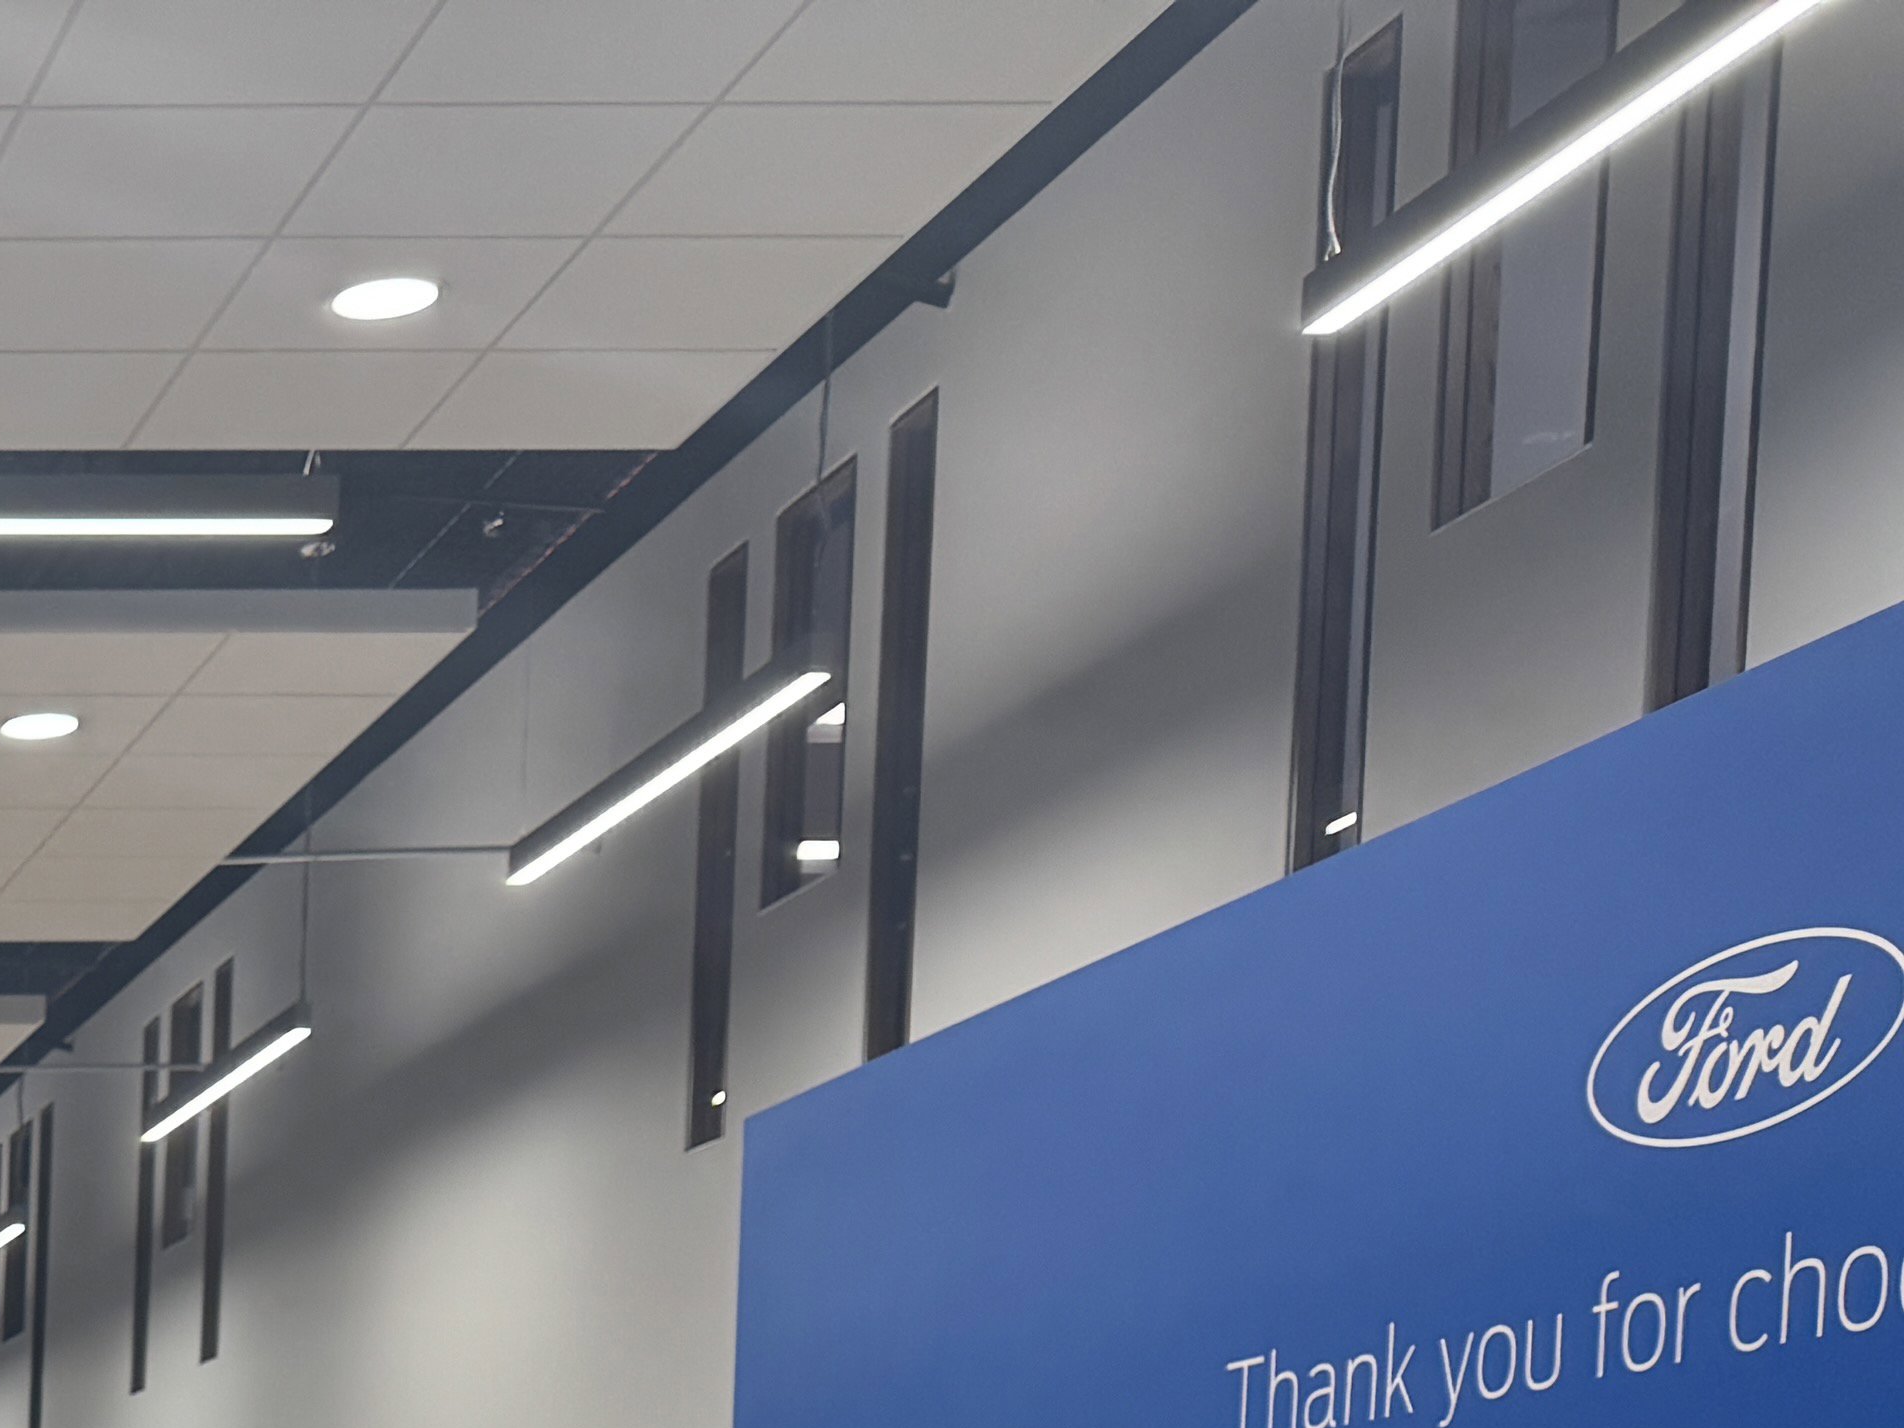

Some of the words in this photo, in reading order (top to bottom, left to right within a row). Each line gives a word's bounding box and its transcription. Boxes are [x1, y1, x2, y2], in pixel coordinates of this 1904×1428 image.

[1636, 960, 1853, 1124] Ford
[1438, 1312, 1563, 1428] you
[1592, 1269, 1702, 1379] for
[1728, 1230, 1904, 1353] cho
